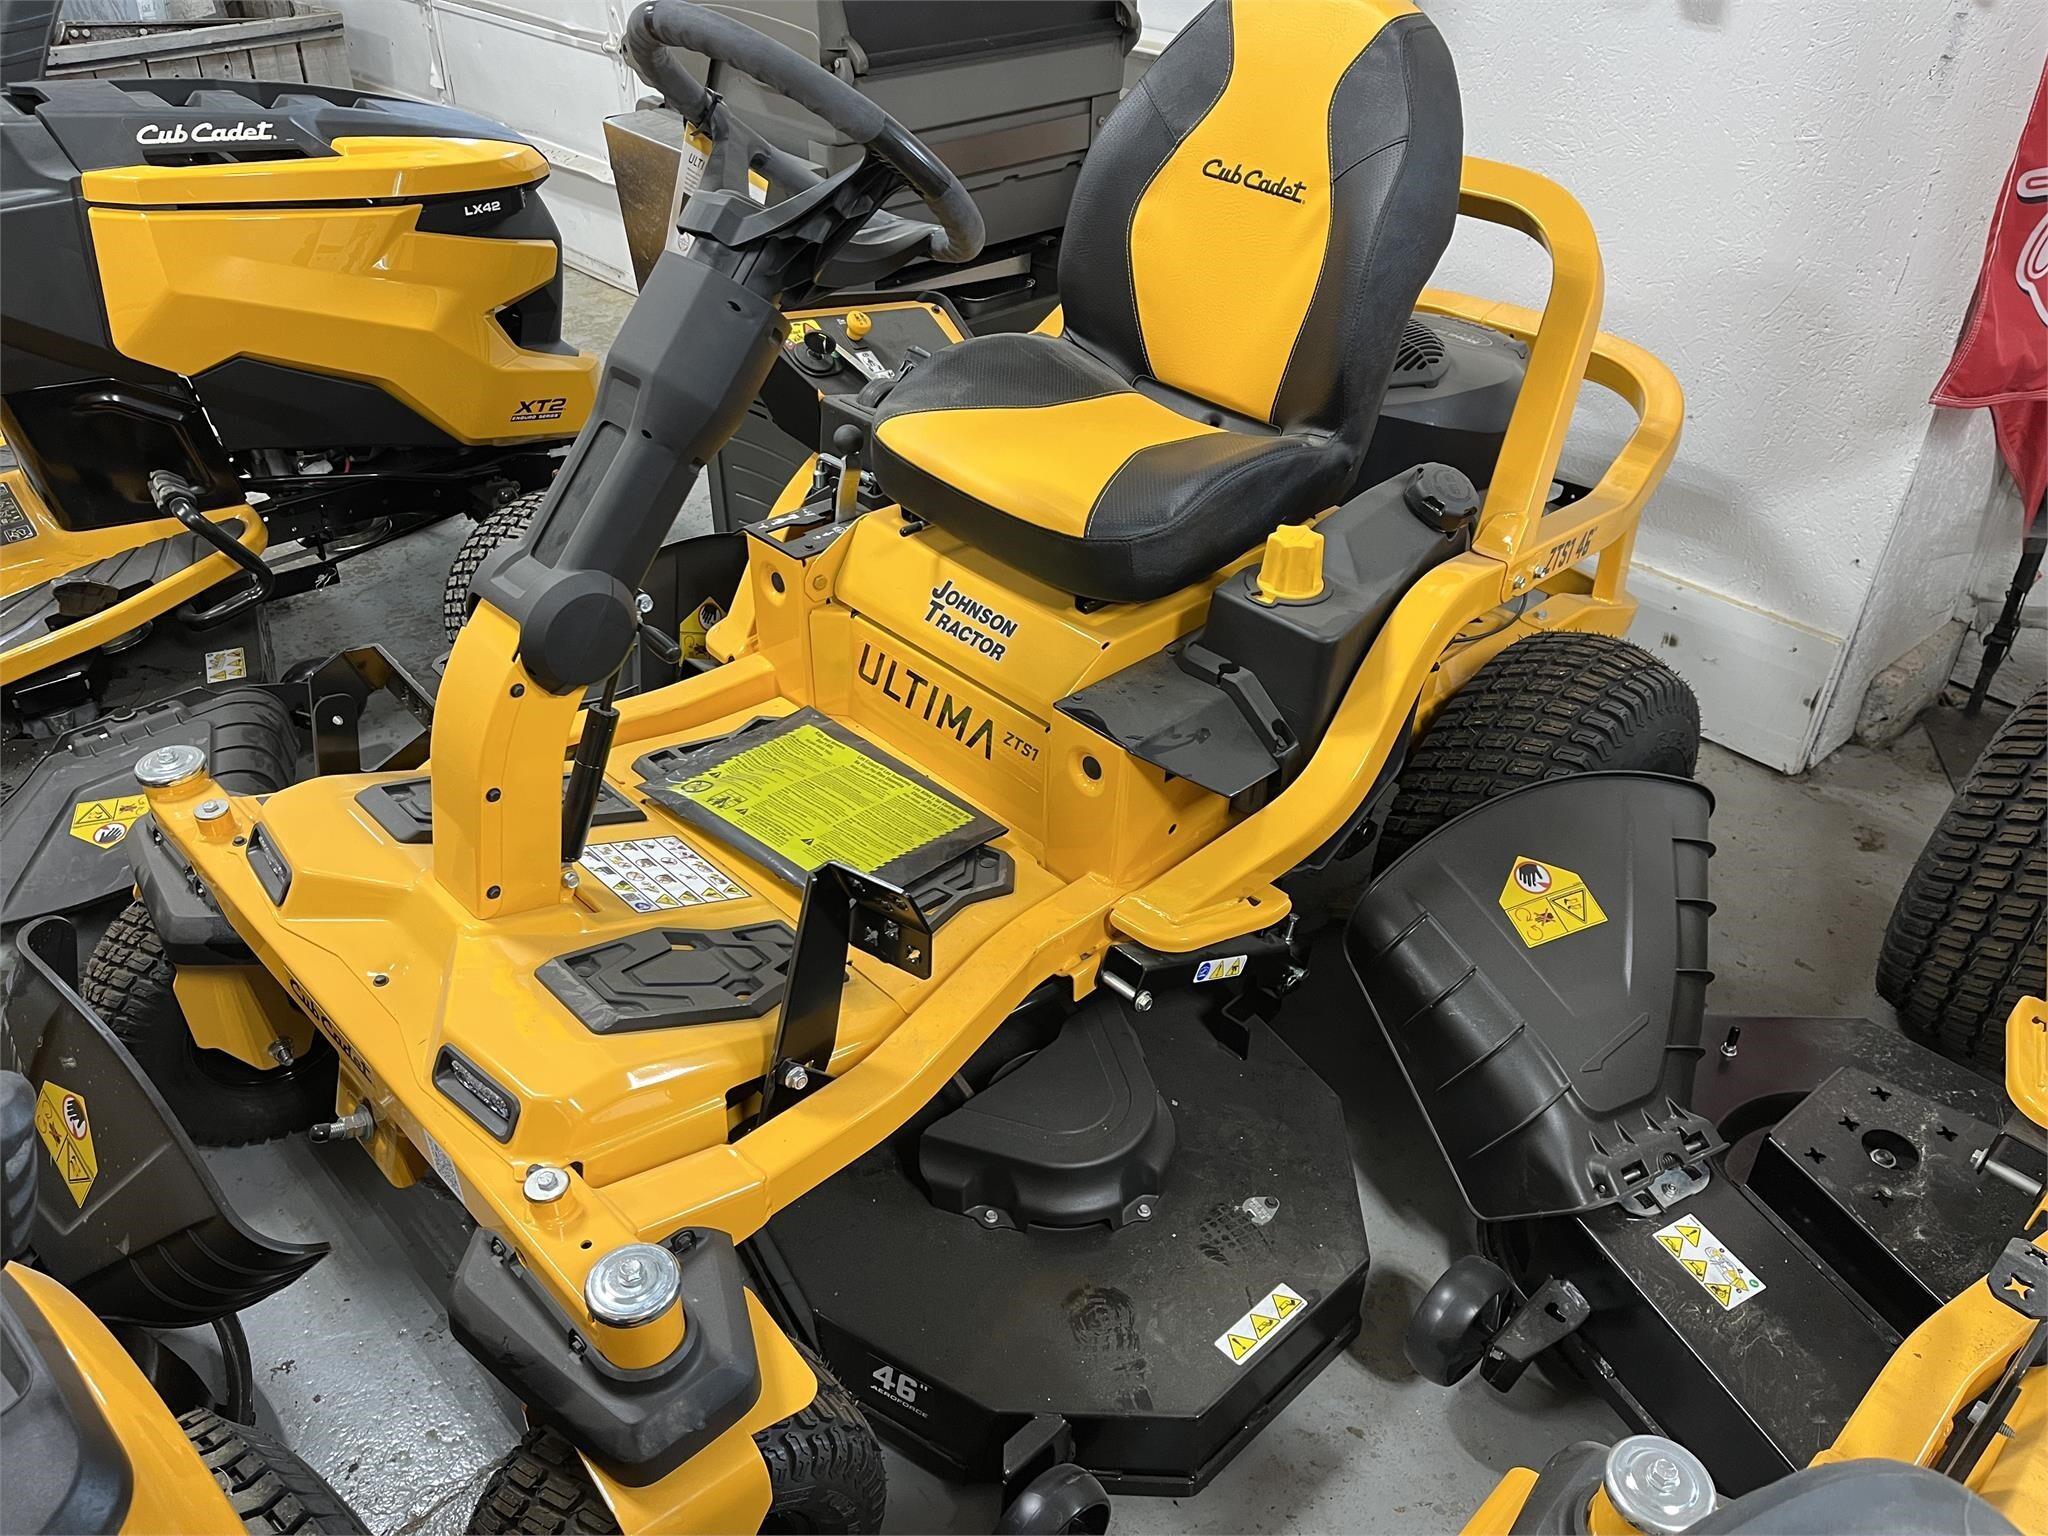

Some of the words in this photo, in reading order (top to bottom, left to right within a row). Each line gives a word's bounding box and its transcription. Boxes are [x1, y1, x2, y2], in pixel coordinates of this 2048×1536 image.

[136, 124, 189, 145] Cub
[190, 121, 275, 142] Cadet
[1202, 159, 1243, 185] Cub
[1243, 169, 1308, 204] Cadet
[464, 200, 501, 216] LX42
[514, 398, 568, 414] XT2
[924, 599, 1007, 661] TRACTOR
[931, 579, 1019, 638] JOHNSON
[857, 643, 994, 761] ULTIMA
[1002, 731, 1040, 762] ZTS1
[289, 978, 320, 1021] Cub
[320, 1015, 373, 1084] Cadet
[869, 1385, 930, 1420] AEROFORCE
